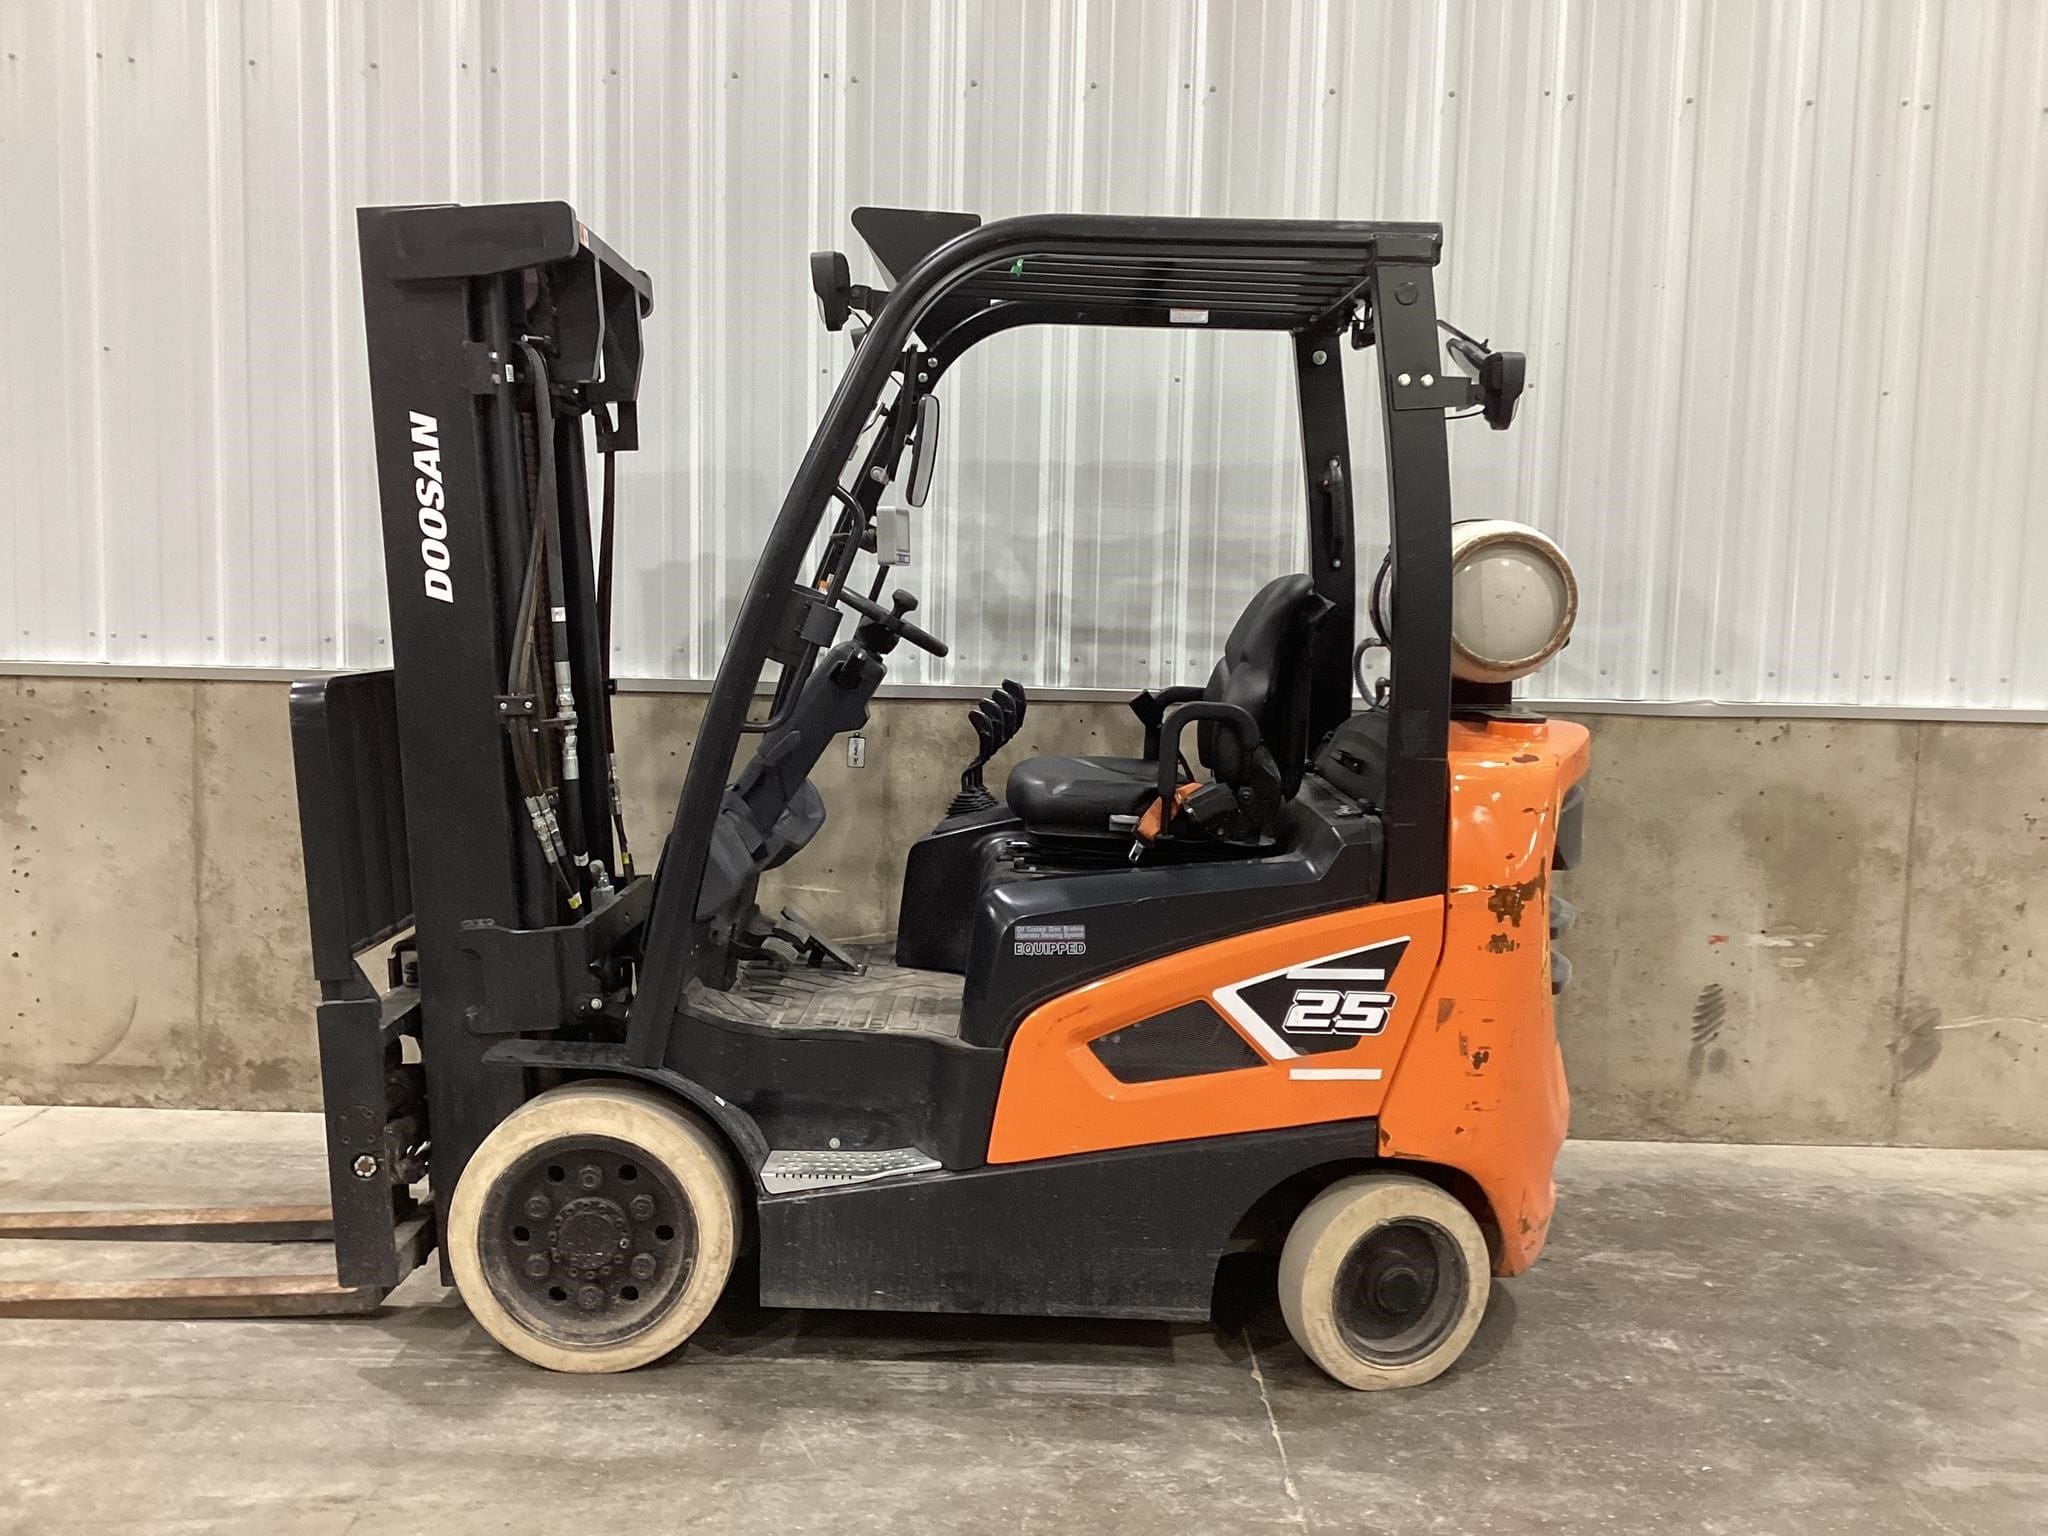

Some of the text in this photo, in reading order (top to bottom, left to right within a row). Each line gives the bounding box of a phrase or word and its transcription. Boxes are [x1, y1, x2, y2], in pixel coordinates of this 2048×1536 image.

[409, 410, 454, 603] DOOSAN
[1014, 942, 1086, 956] EQUIPPED
[1282, 990, 1397, 1037] 25
